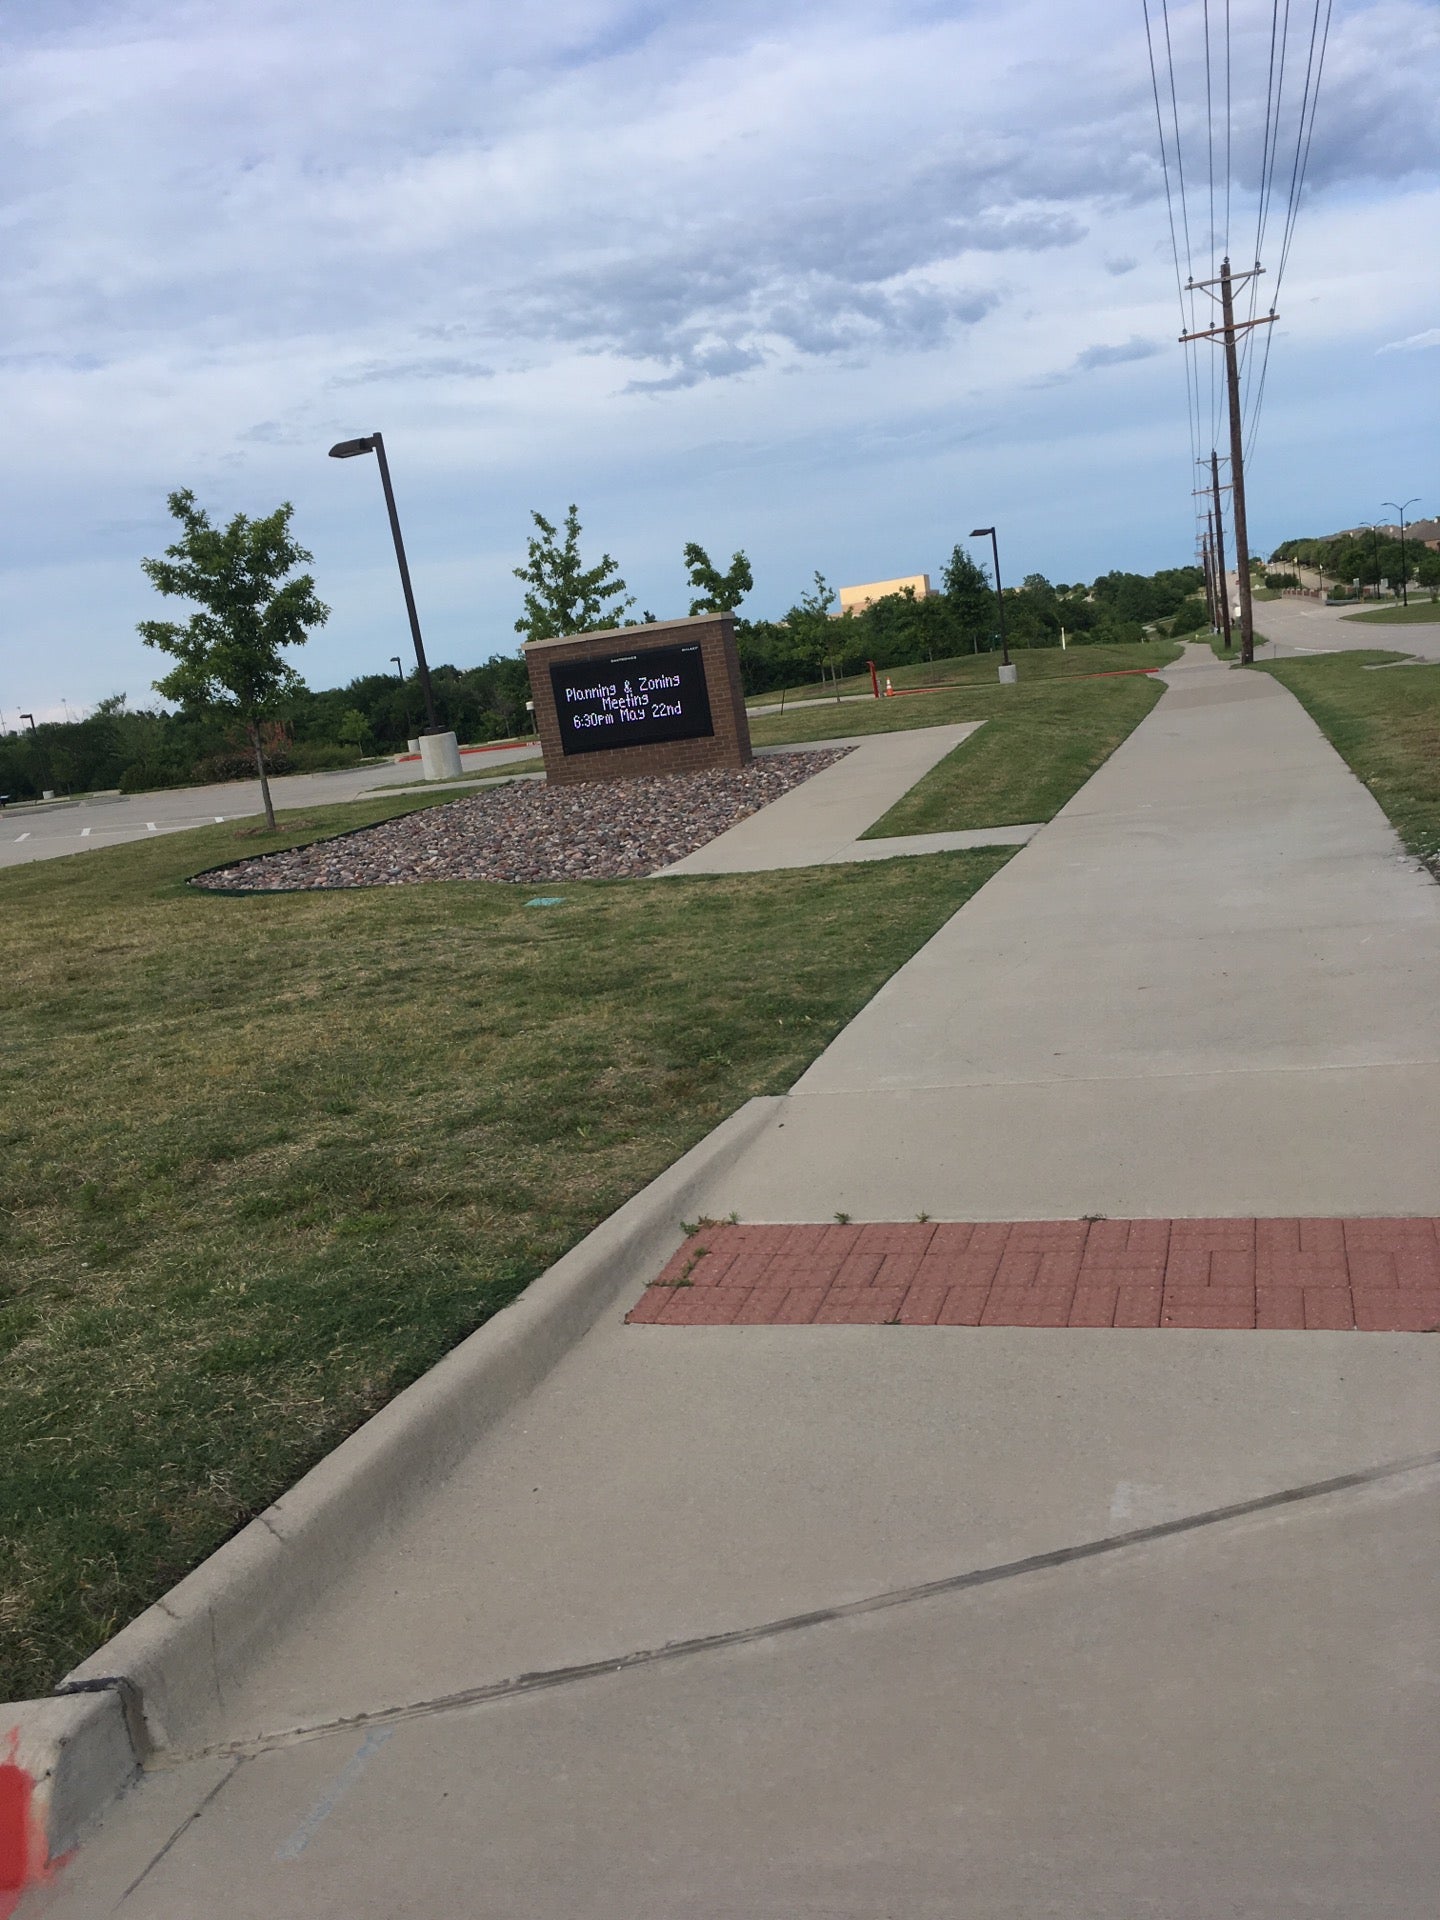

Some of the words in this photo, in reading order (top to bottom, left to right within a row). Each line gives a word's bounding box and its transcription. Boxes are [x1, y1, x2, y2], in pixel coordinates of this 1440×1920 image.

[565, 684, 617, 703] Planning
[623, 679, 633, 693] &
[638, 674, 681, 692] Zoning
[602, 692, 649, 711] Meeting
[573, 712, 615, 729] 6:30pm
[619, 707, 646, 722] May
[651, 700, 682, 718] 22nd
